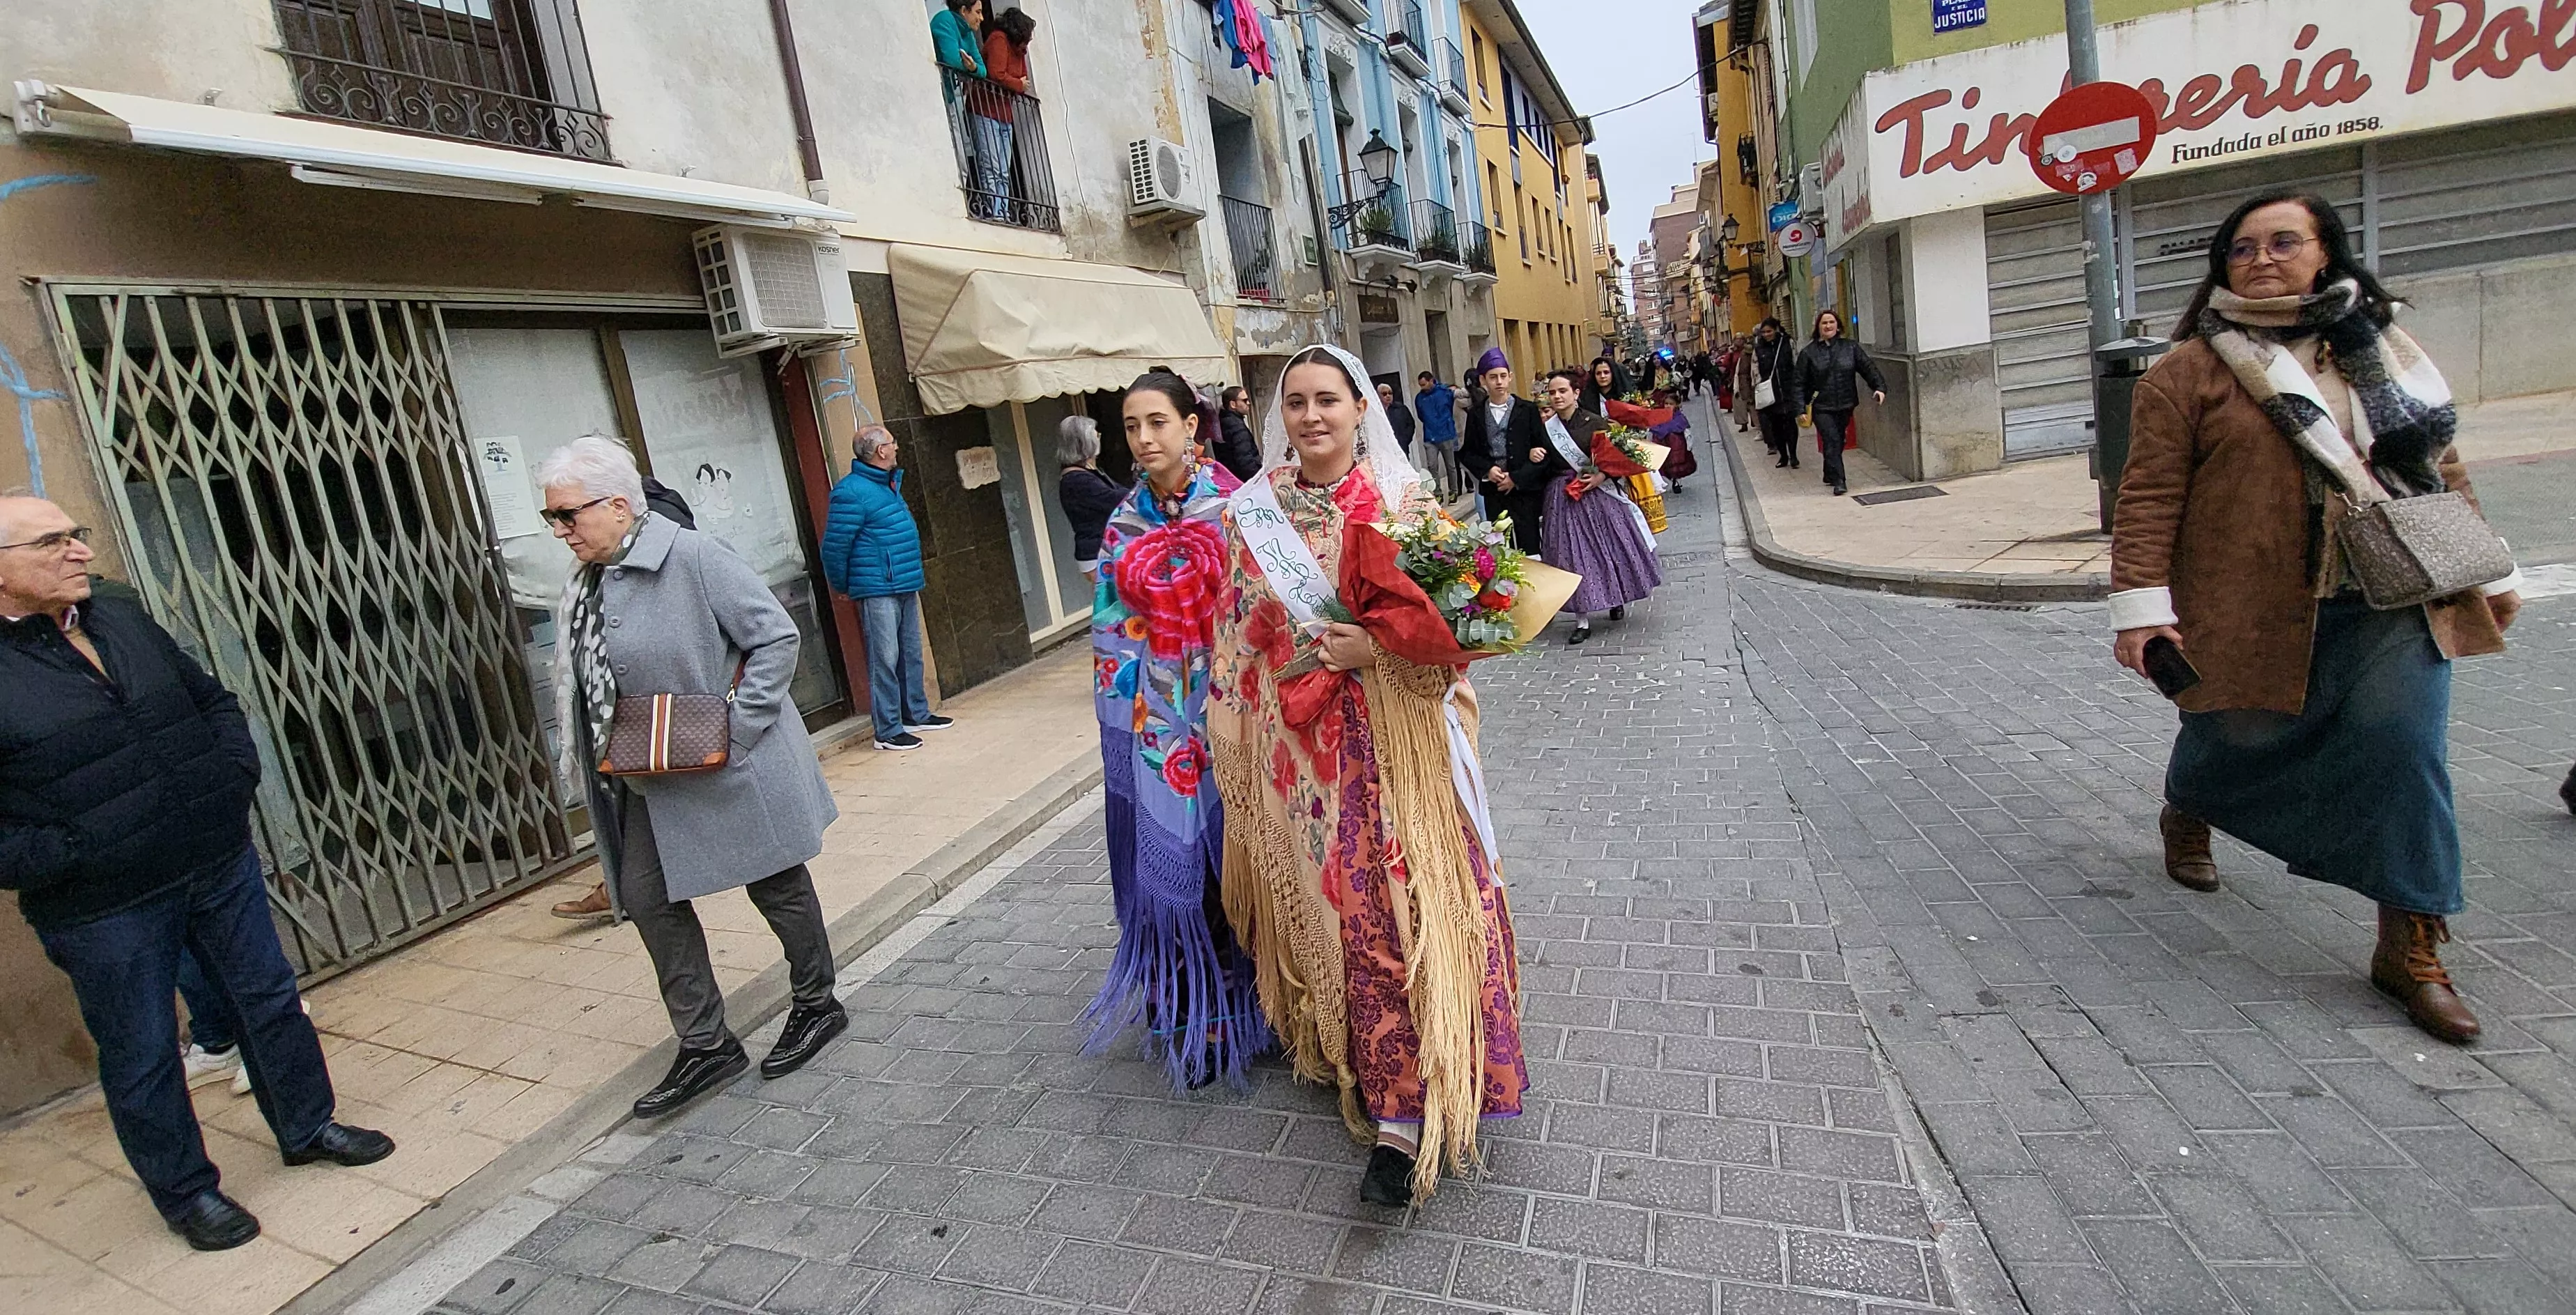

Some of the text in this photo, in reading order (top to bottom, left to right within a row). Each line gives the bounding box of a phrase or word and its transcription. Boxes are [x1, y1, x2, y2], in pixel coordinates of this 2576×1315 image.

[1934, 7, 1985, 29] JUSTICIA
[2405, 0, 2576, 94] Pol
[2170, 116, 2384, 164] Fundada el año 1858.
